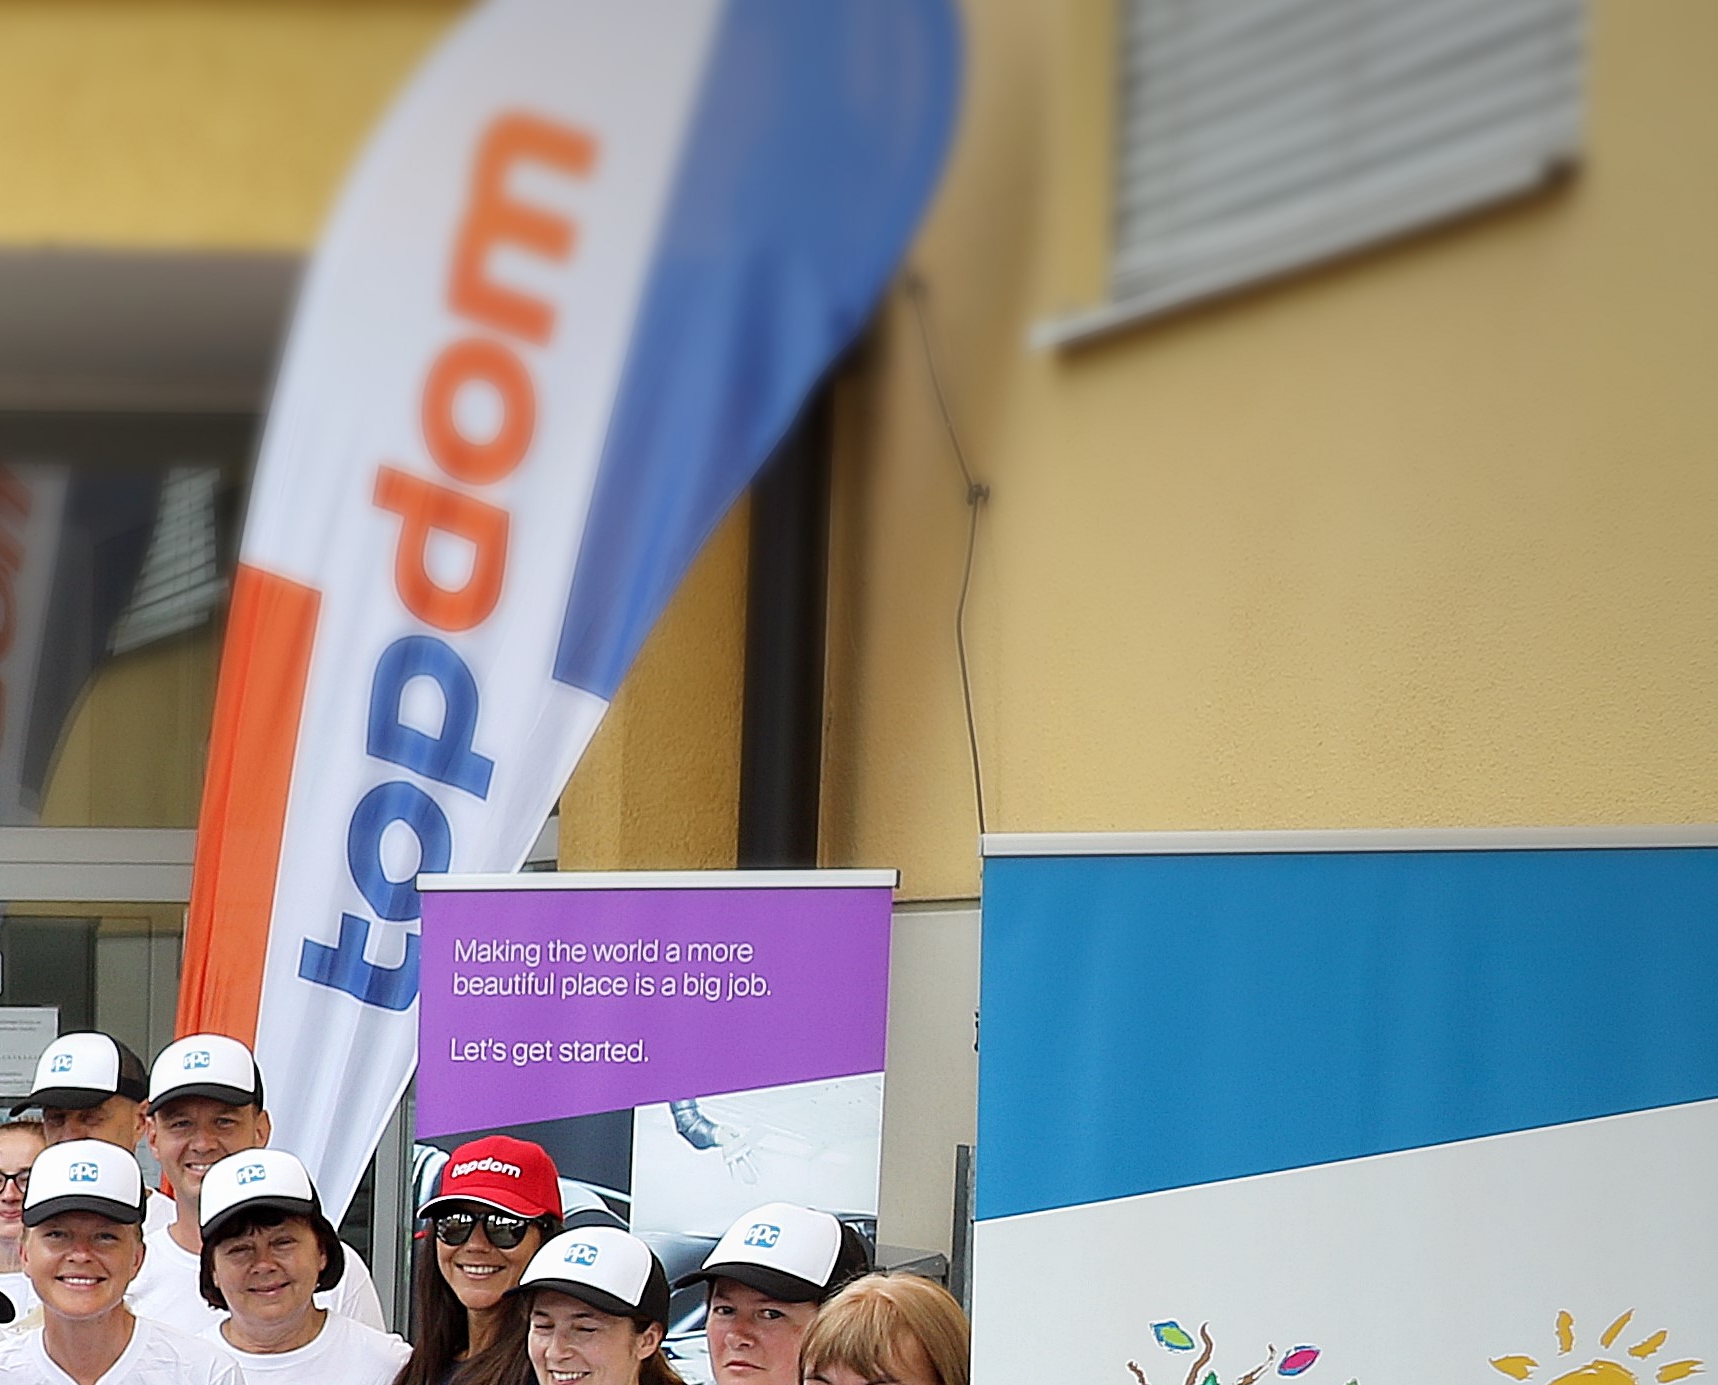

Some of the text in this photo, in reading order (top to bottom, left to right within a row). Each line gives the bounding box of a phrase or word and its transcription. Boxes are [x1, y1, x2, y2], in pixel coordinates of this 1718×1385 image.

[298, 107, 597, 1013] topdom
[454, 938, 754, 967] Making the world a more
[452, 972, 772, 1000] beautiful place is a big job.
[184, 1051, 210, 1069] PPG
[450, 1037, 649, 1067] Let's get started.
[69, 1162, 99, 1182] PPG
[236, 1164, 266, 1184] PPG
[451, 1157, 521, 1180] topdom
[745, 1223, 782, 1248] PPG
[564, 1243, 598, 1267] PPG
